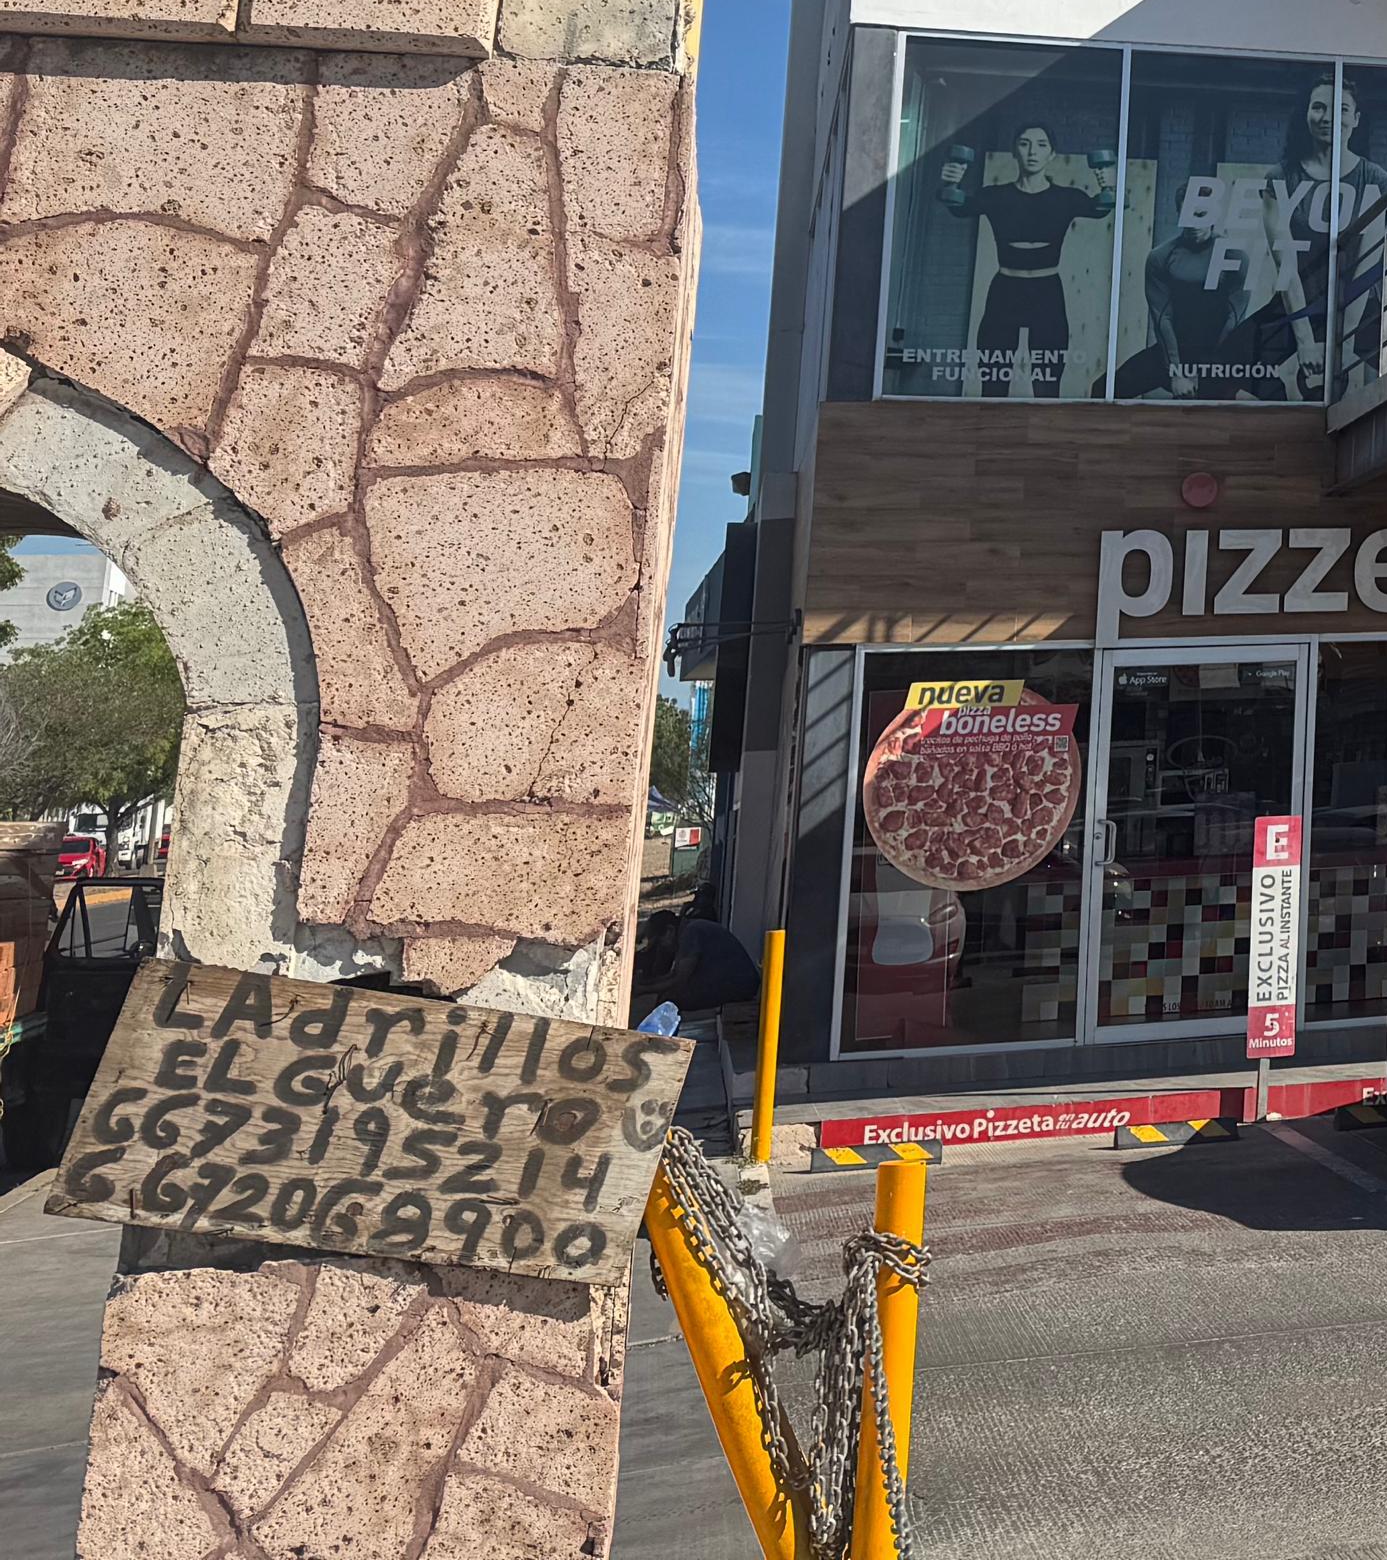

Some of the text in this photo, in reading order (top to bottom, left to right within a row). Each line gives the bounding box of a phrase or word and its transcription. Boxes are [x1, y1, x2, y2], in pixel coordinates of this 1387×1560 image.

[1204, 238, 1311, 291] FIT
[902, 347, 1088, 366] ENTRENAMIENTO
[931, 366, 1058, 382] FUNCIONAL
[1168, 360, 1280, 379] NUTRICIÓN
[1129, 675, 1167, 686] App Store
[918, 683, 1006, 706] nueva
[940, 708, 1062, 735] boneless
[957, 705, 992, 718] pizza
[1266, 824, 1289, 860] E
[1257, 873, 1276, 1003] EXCLUSIVO
[1277, 869, 1293, 1001] PIZZA AL INSTANTE
[1264, 1013, 1280, 1037] 5
[1248, 1037, 1293, 1049] Minutos
[154, 1039, 258, 1096] EL
[863, 1109, 1054, 1145] Exclusivo Pizzeta
[1072, 1108, 1131, 1129] auto
[93, 1086, 613, 1213] 6673195214
